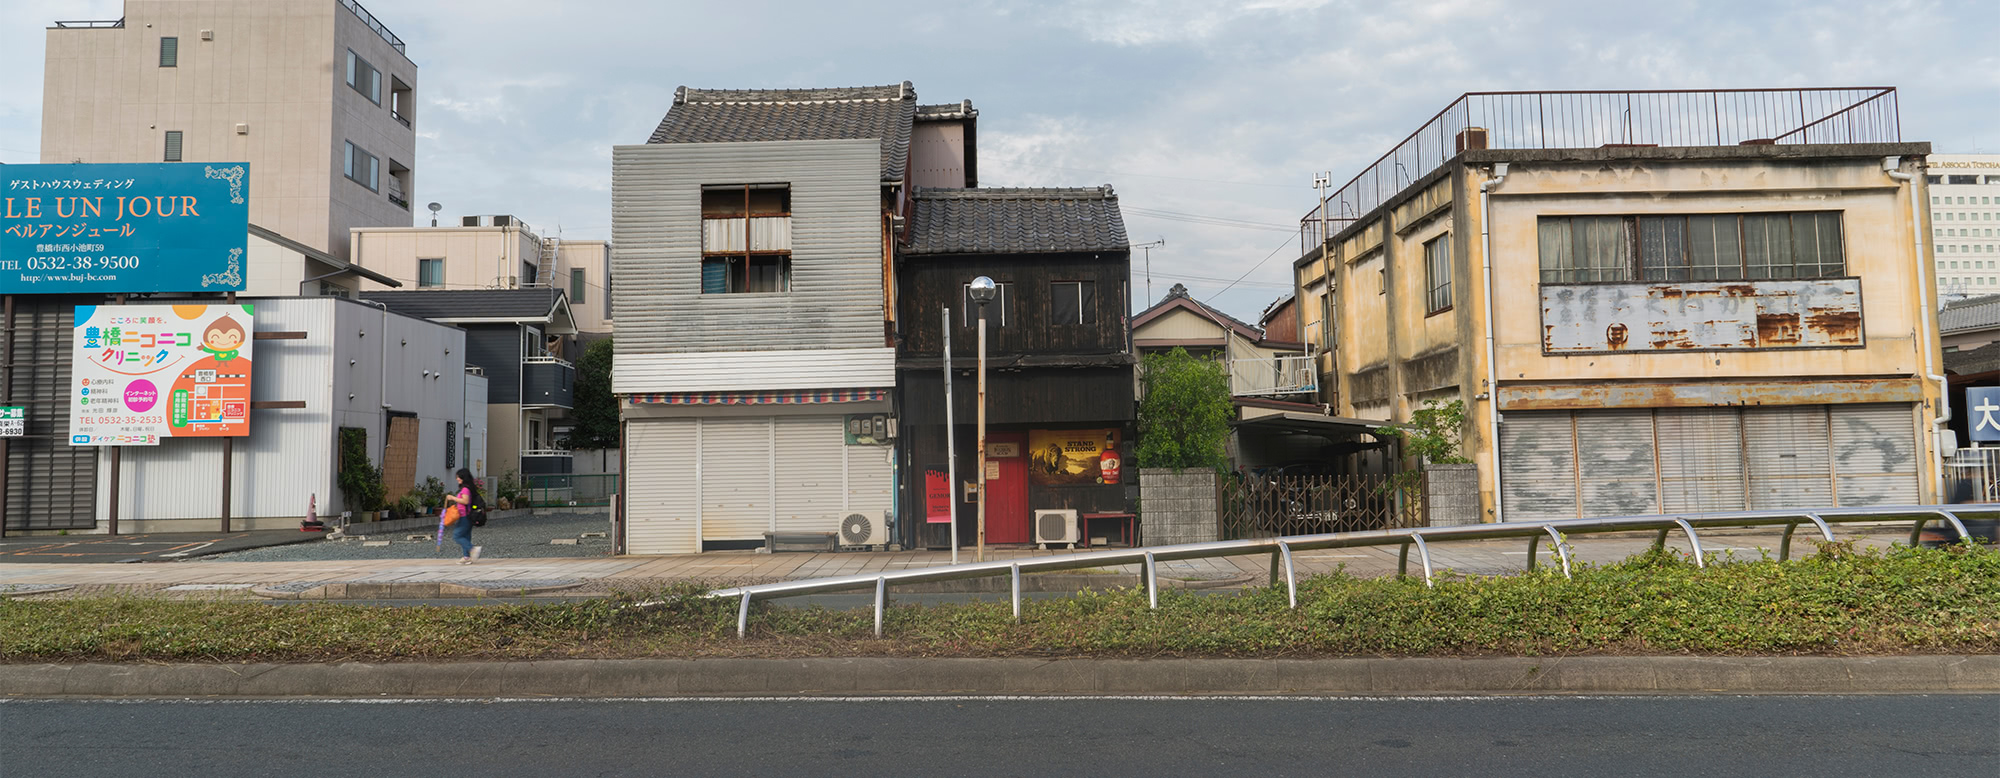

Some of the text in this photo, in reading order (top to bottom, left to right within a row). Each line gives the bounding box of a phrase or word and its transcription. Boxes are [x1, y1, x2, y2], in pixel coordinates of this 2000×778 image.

[10, 178, 135, 190] ゲストハウスウェディング
[0, 196, 200, 221] LE UN JOUR
[5, 223, 136, 239] ベルアンジュール
[0, 256, 139, 270] TEL 0532-38-9500
[21, 273, 116, 283] http://www.buj-bc.com
[83, 326, 191, 349] 豊橋ニコニコ
[102, 347, 169, 367] クリニック
[98, 416, 163, 424] 0532-35-2533
[1974, 397, 2000, 432] 大
